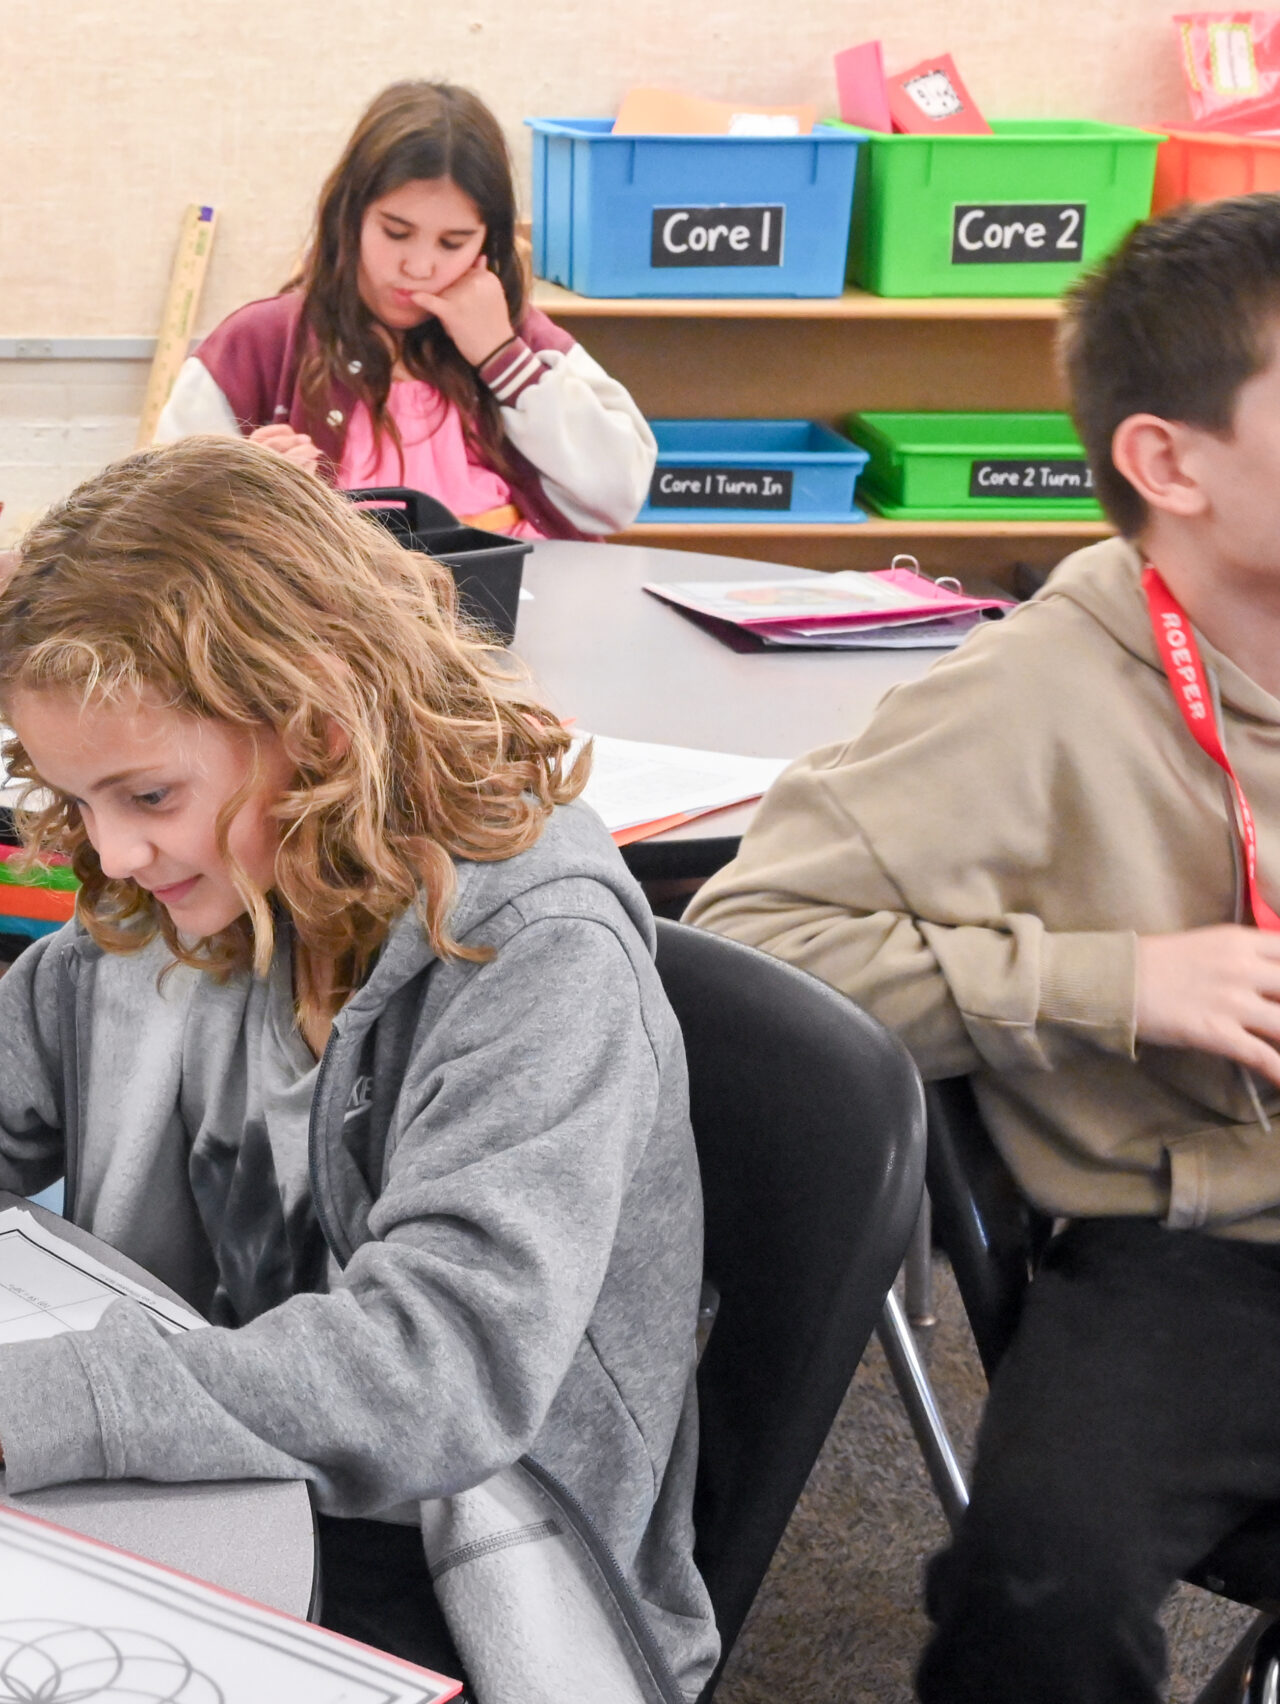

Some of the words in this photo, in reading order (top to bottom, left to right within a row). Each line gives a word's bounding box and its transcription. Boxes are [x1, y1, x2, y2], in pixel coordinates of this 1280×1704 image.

[662, 211, 751, 253] Core
[761, 210, 772, 252] 1
[957, 208, 1047, 251] Core
[1055, 207, 1080, 249] 2
[659, 473, 701, 494] Core
[704, 474, 712, 495] 1
[715, 474, 758, 495] Turn
[761, 475, 783, 496] In
[977, 466, 1020, 487] Core
[1022, 466, 1036, 488] 2
[1039, 466, 1081, 487] Turn
[1159, 611, 1207, 720] ROEPER
